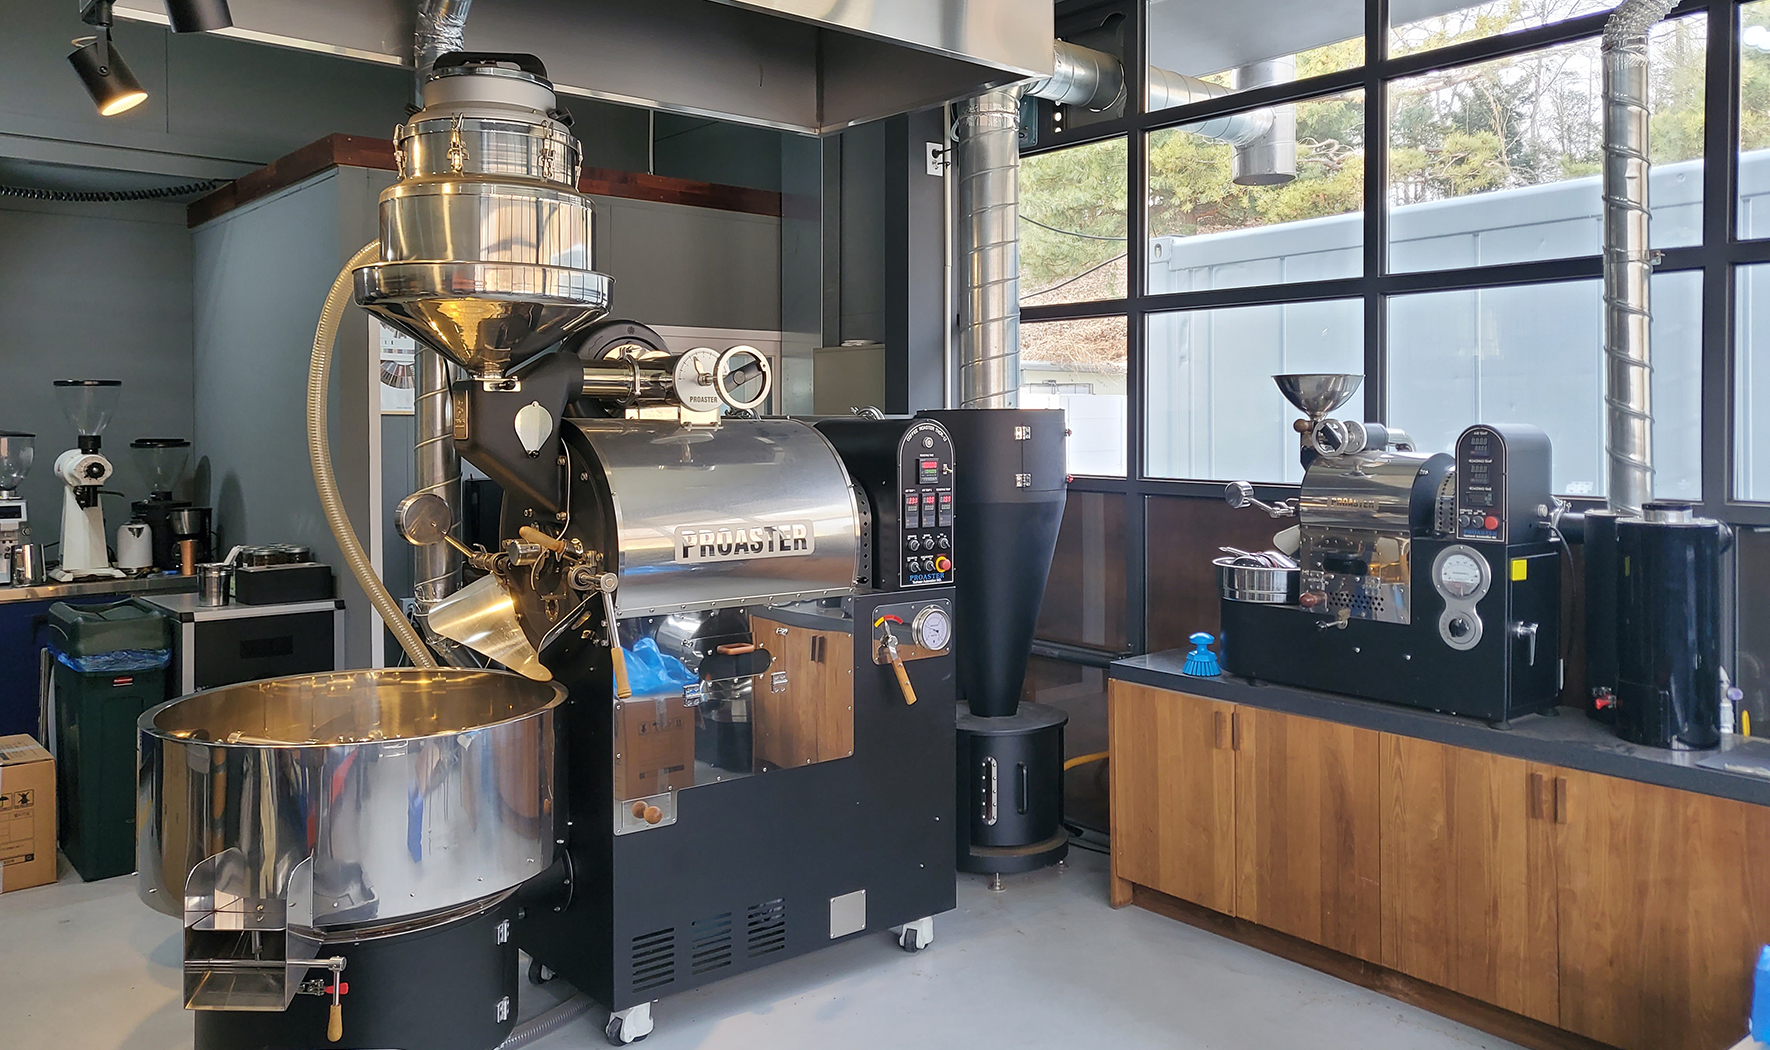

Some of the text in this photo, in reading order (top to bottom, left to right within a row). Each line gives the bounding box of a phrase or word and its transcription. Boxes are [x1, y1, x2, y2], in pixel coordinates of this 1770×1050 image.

[689, 395, 718, 404] PROASTER
[906, 428, 919, 442] COFFEE
[1331, 497, 1375, 508] PROASTER
[681, 523, 808, 559] PROASTER
[909, 572, 945, 581] PROASTER
